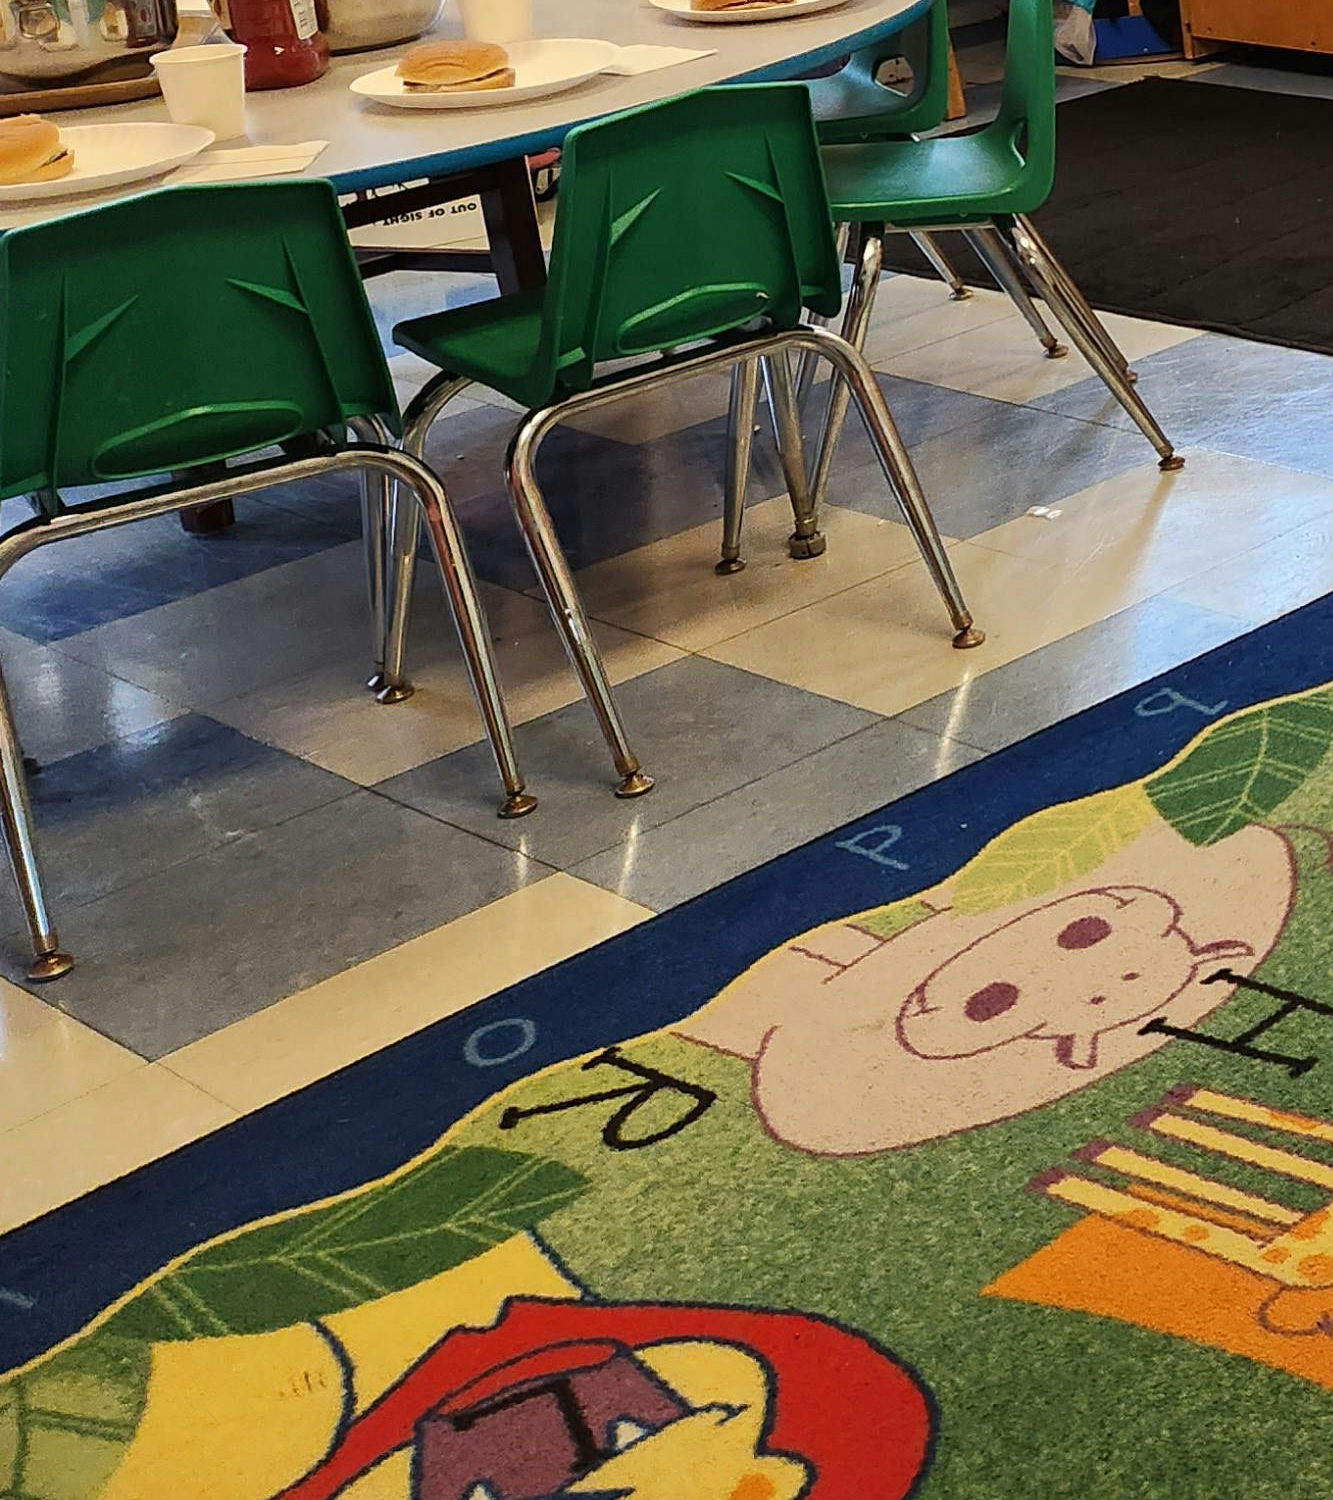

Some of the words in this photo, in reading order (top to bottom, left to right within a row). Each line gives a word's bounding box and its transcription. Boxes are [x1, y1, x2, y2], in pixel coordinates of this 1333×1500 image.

[429, 208, 446, 218] OF
[450, 202, 477, 215] OUT
[498, 1046, 718, 1153] R
